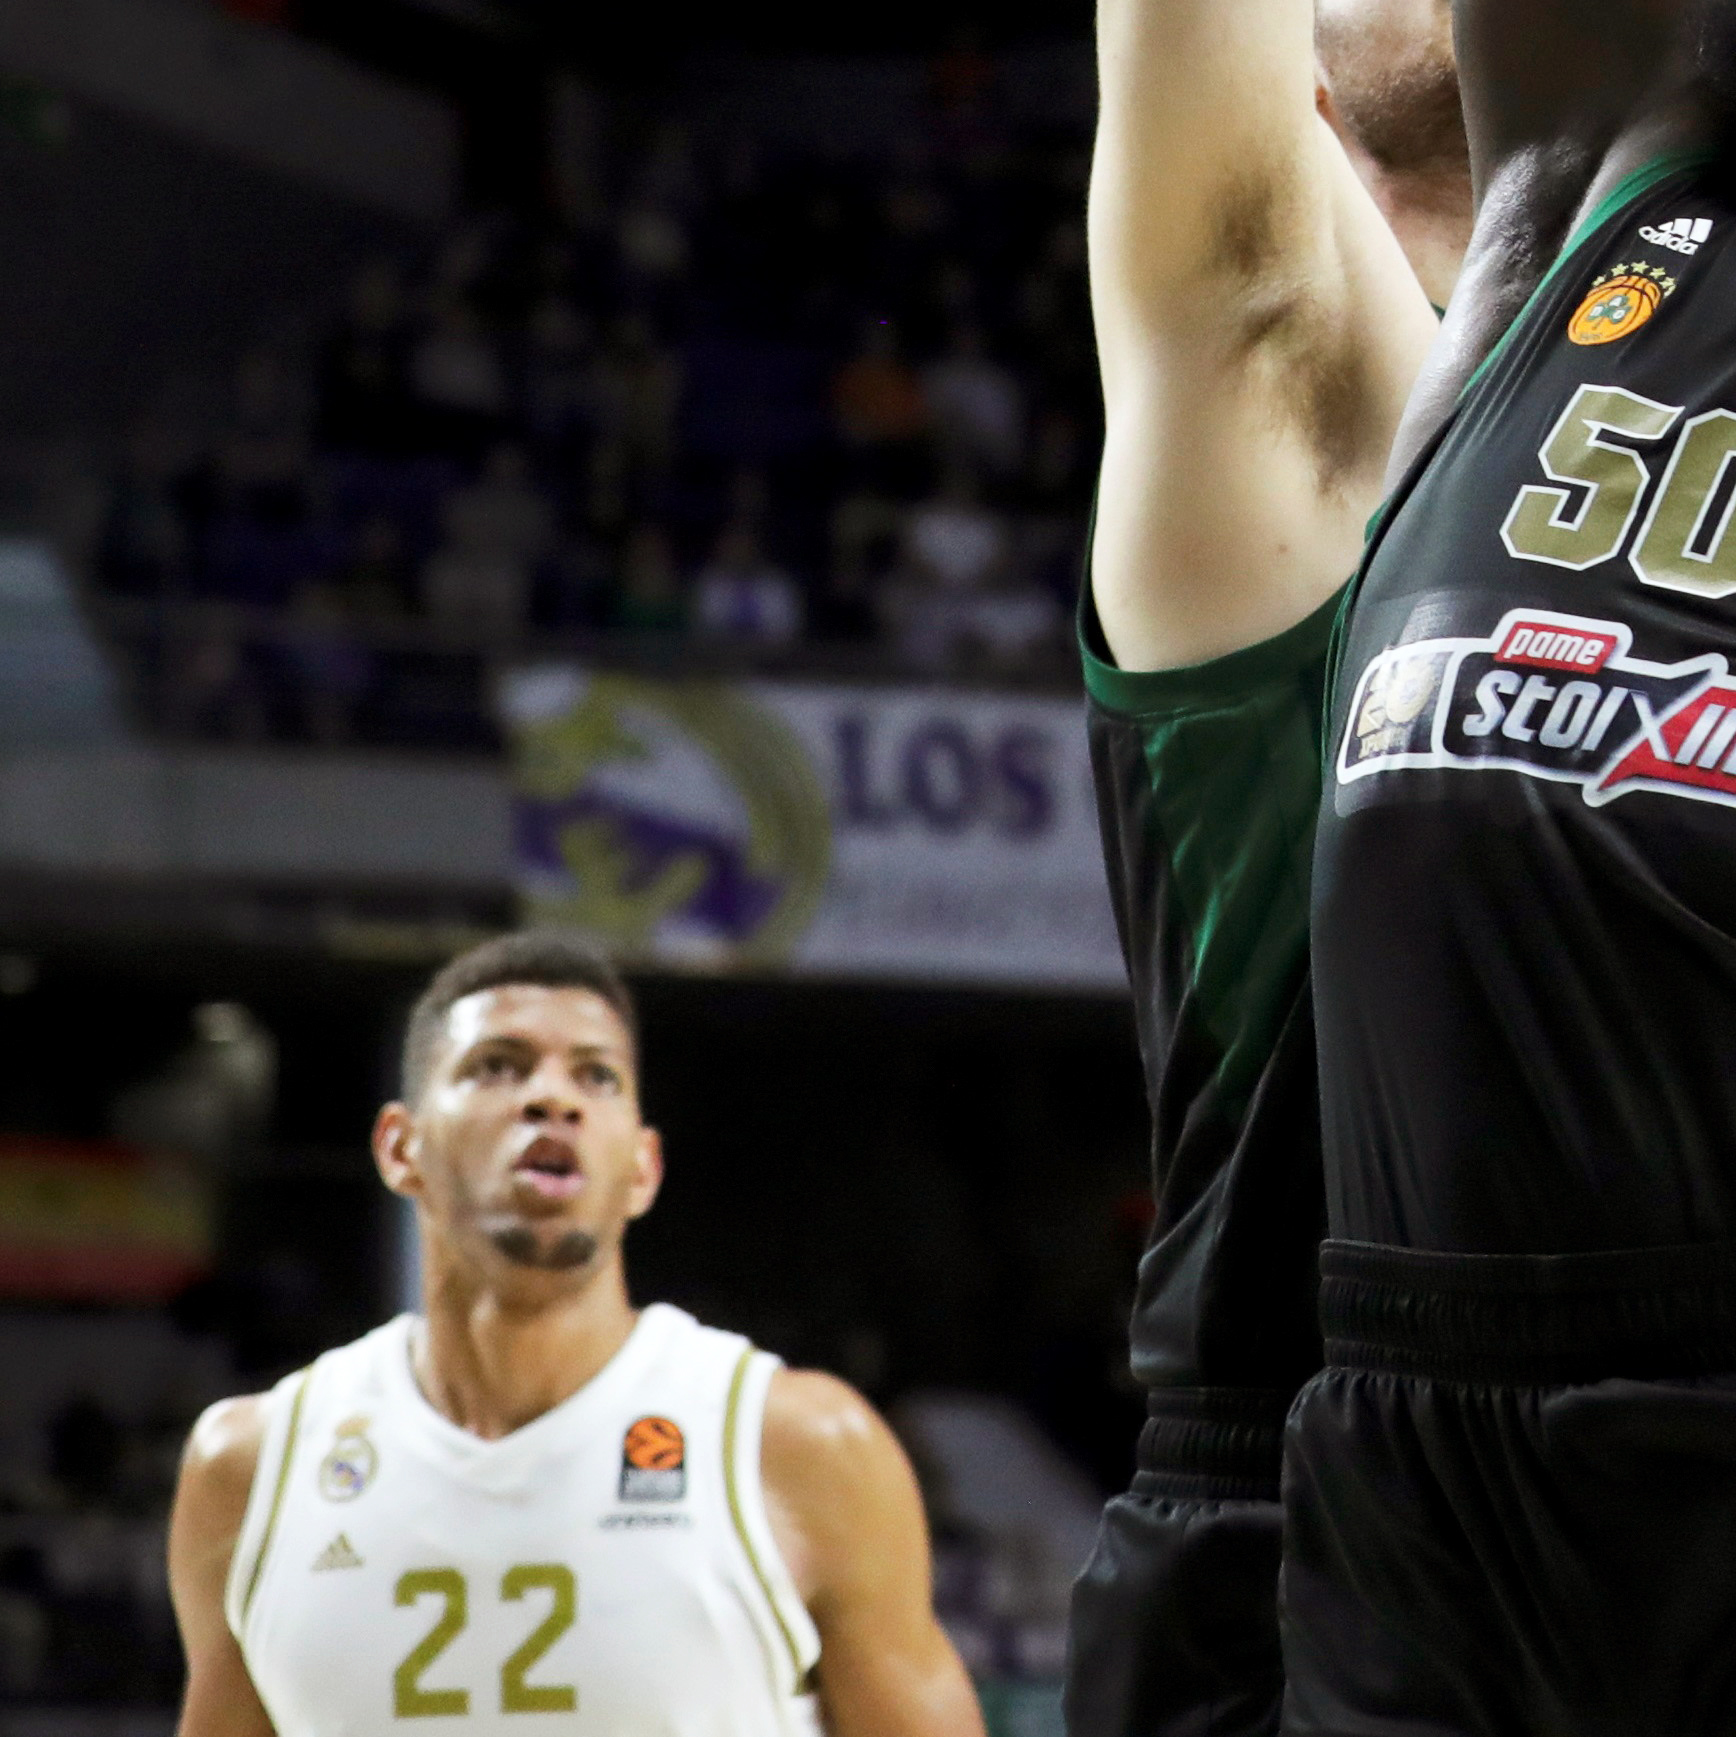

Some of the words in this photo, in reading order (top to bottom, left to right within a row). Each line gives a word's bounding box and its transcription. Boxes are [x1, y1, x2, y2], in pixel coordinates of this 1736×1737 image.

[1638, 225, 1699, 256] adida
[1503, 628, 1606, 666] pame
[833, 711, 1057, 842] LOS
[391, 1562, 578, 1720] 22
